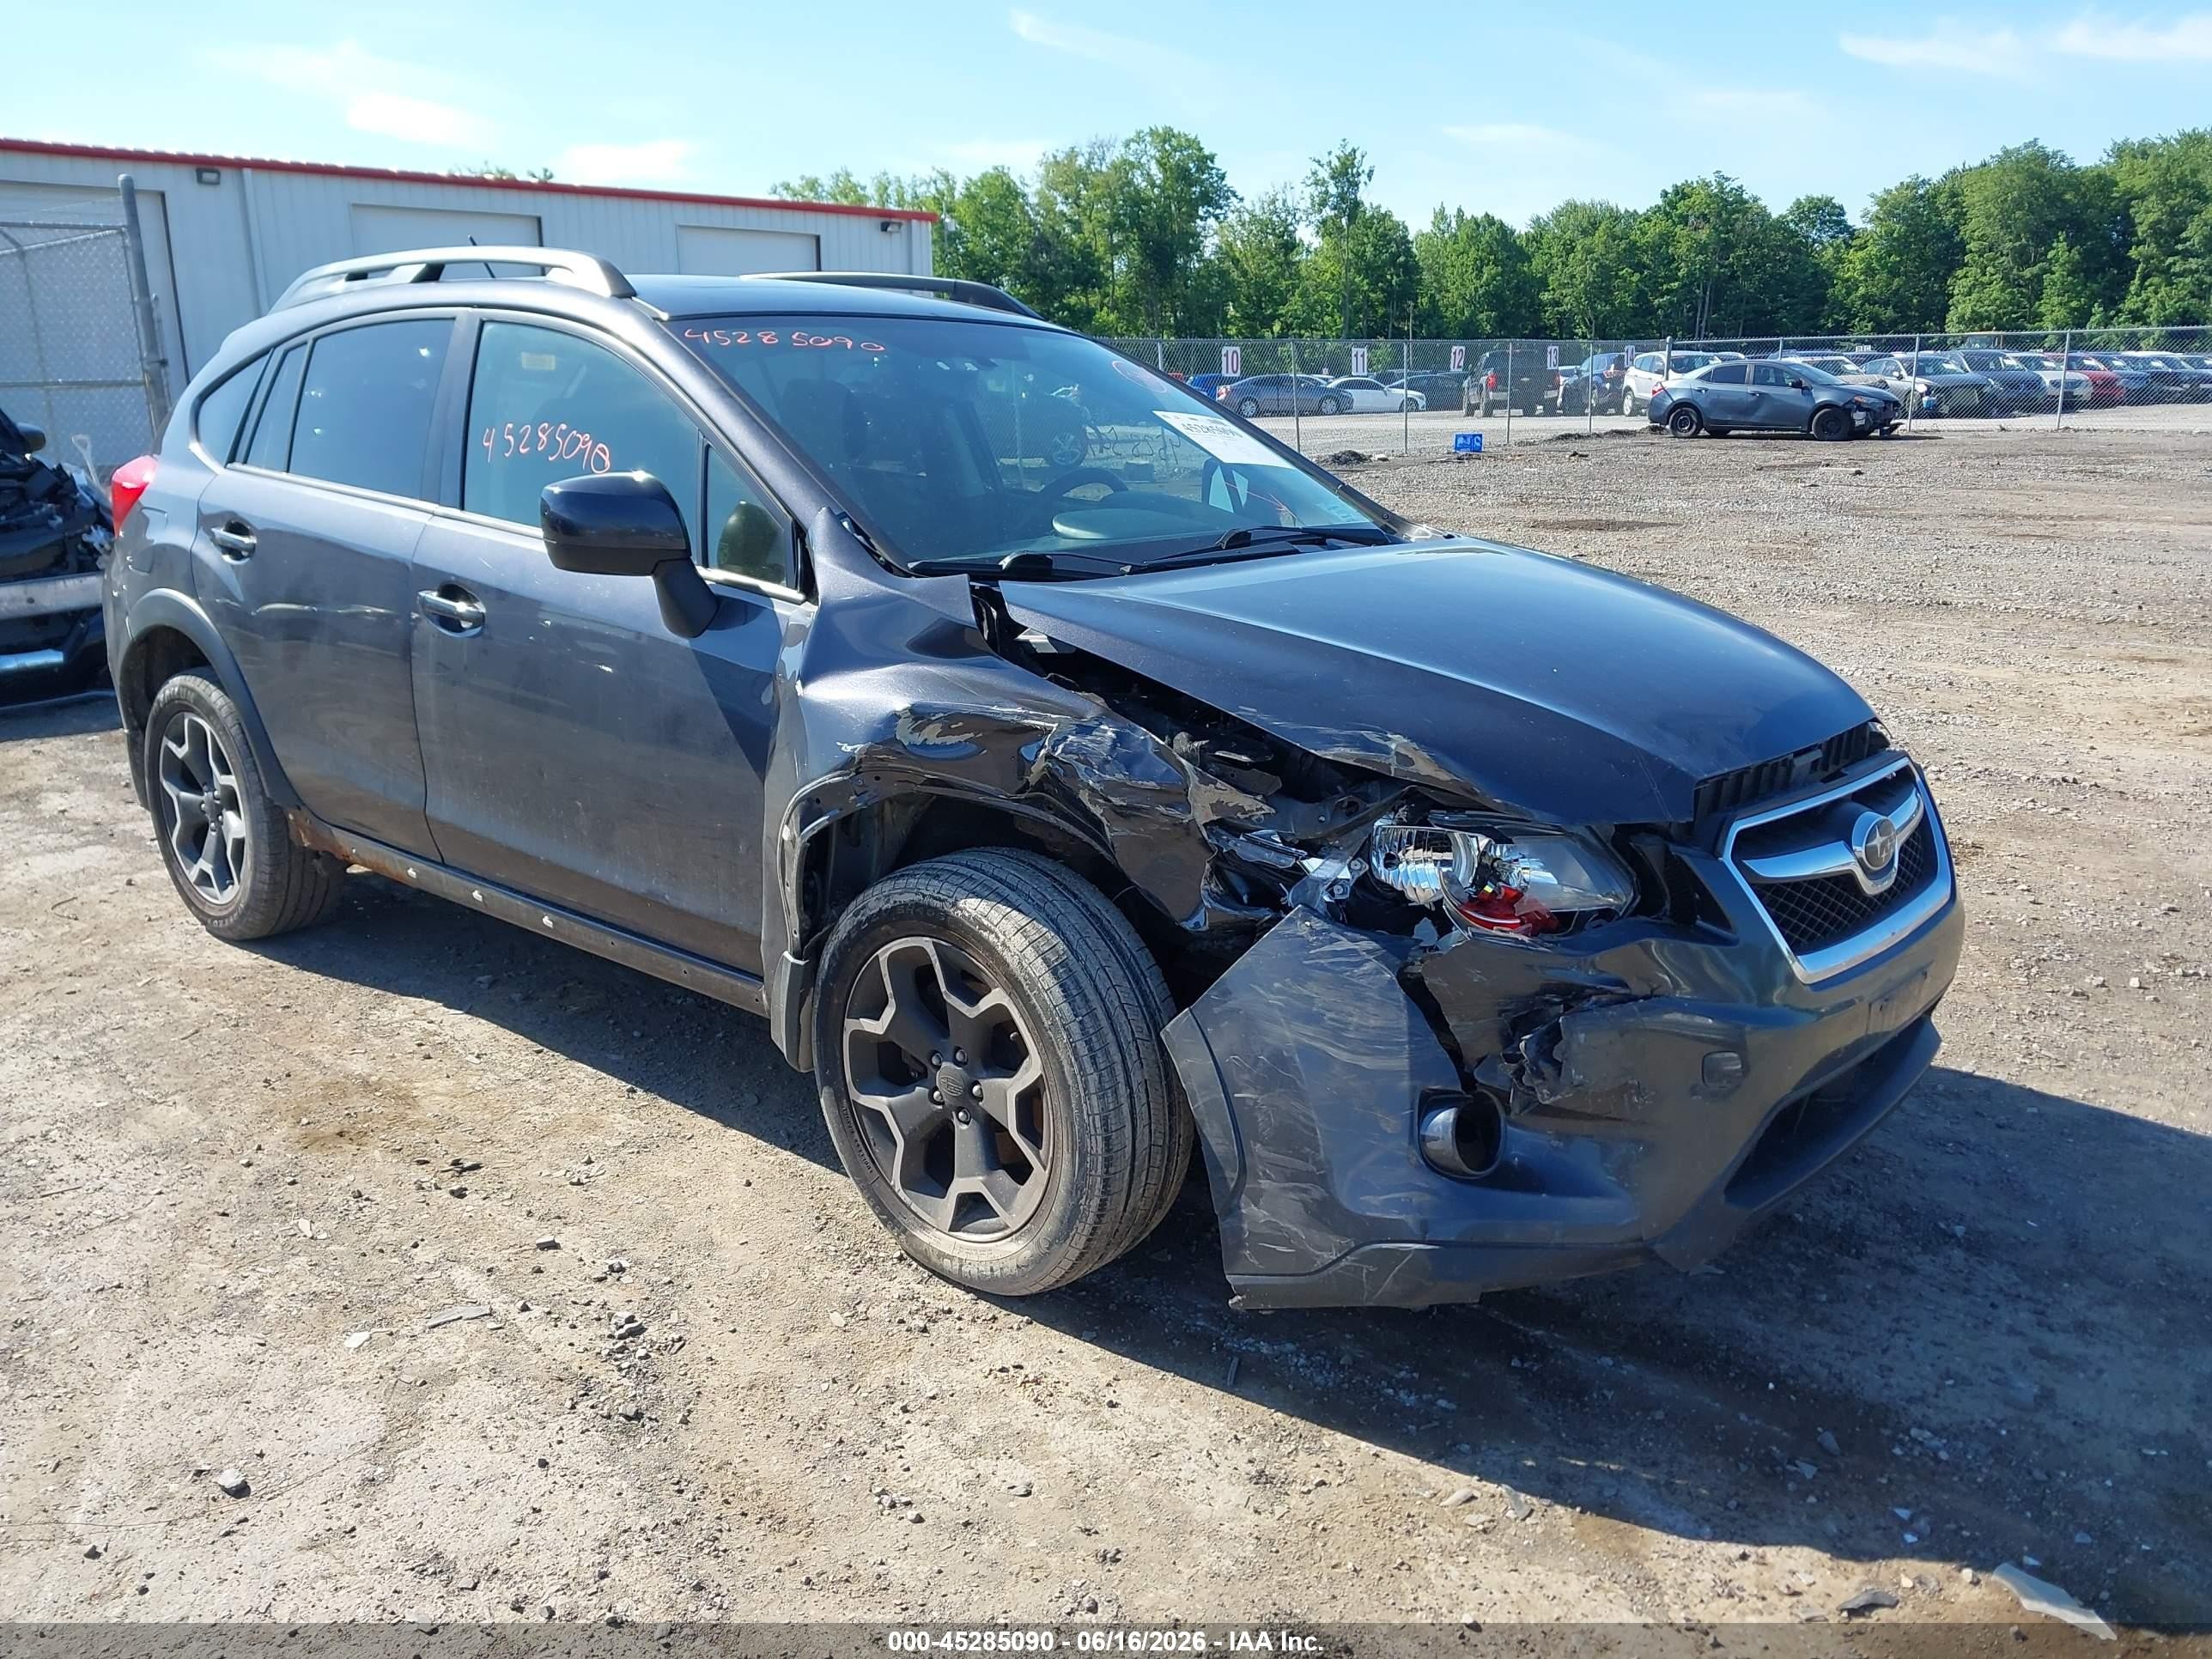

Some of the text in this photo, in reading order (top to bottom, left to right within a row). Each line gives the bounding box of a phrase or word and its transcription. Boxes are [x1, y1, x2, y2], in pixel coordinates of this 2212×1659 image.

[1223, 349, 1239, 374] 10
[1353, 350, 1366, 373] 11
[1452, 349, 1464, 369] 12
[1548, 348, 1558, 368] 13
[482, 422, 611, 474] 45285090
